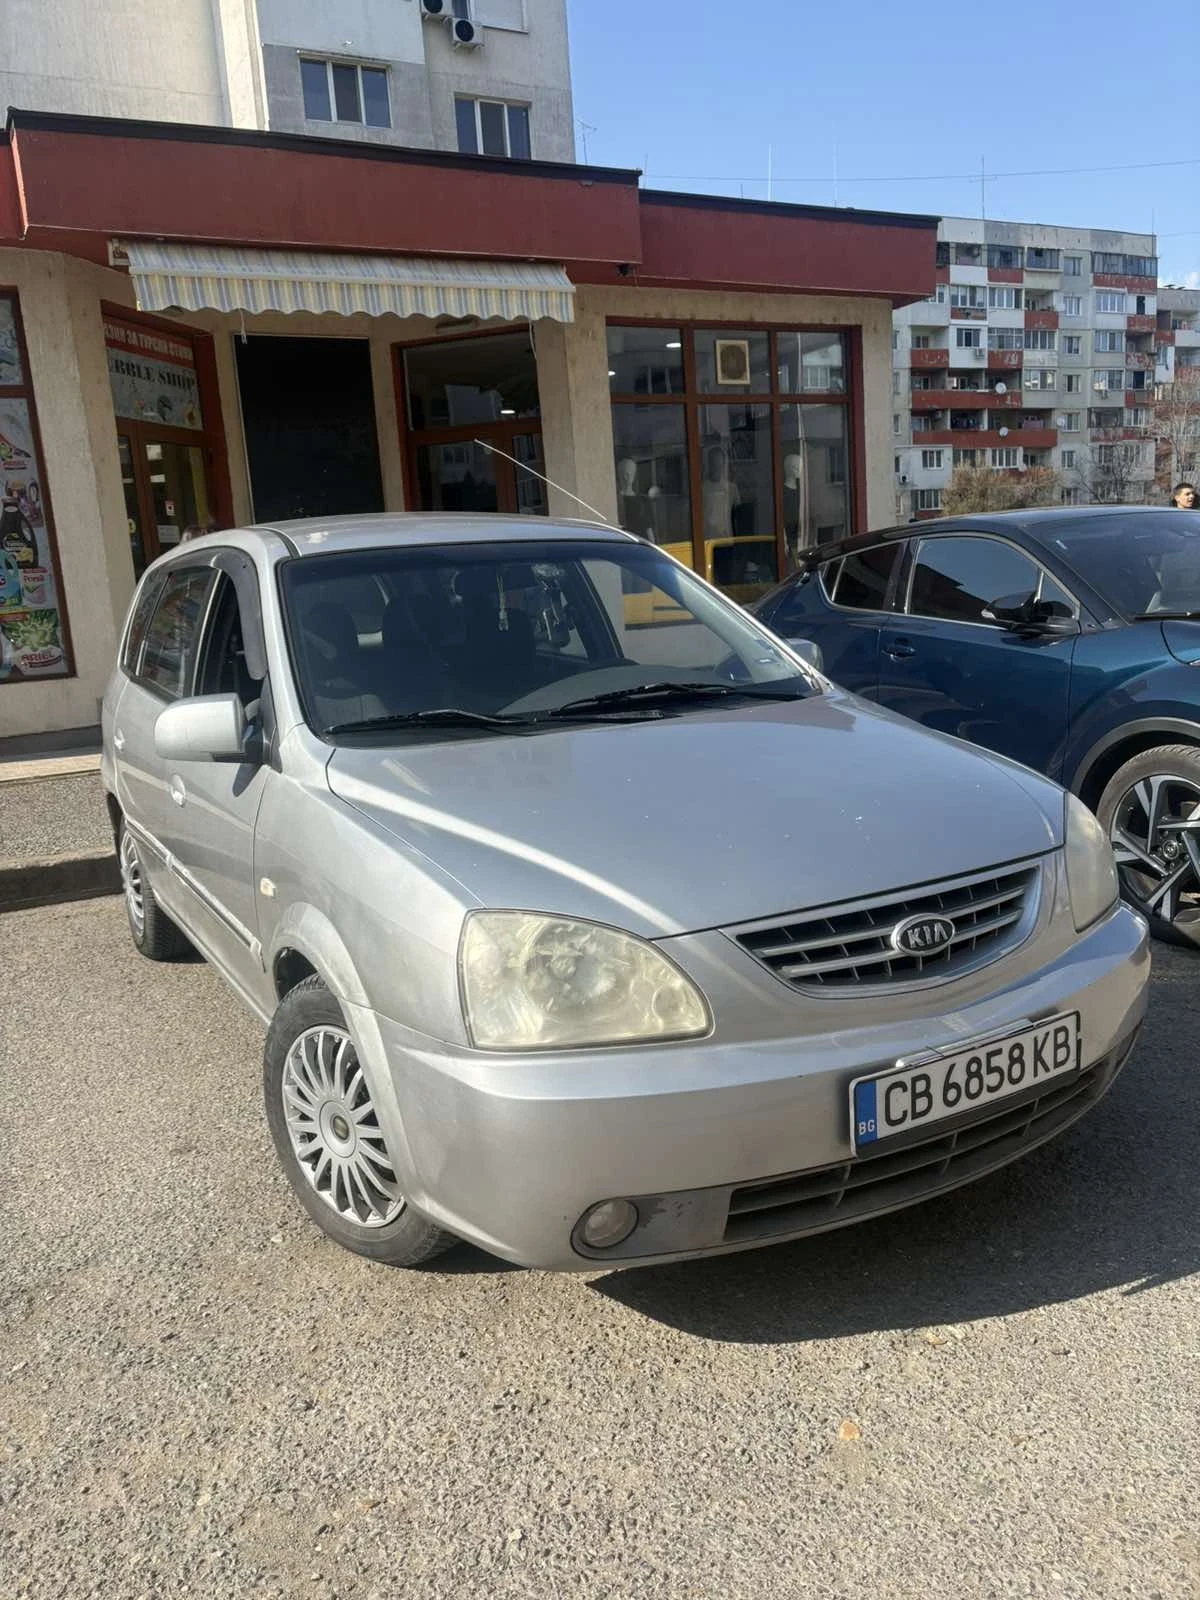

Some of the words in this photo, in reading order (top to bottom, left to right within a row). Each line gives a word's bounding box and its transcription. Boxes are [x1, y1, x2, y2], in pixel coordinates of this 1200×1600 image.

[110, 359, 154, 381] BBLE
[907, 923, 948, 948] KIA
[885, 1073, 933, 1127] CB
[943, 1042, 1025, 1107] 6858
[1033, 1025, 1070, 1078] KB
[858, 1120, 875, 1136] BG
